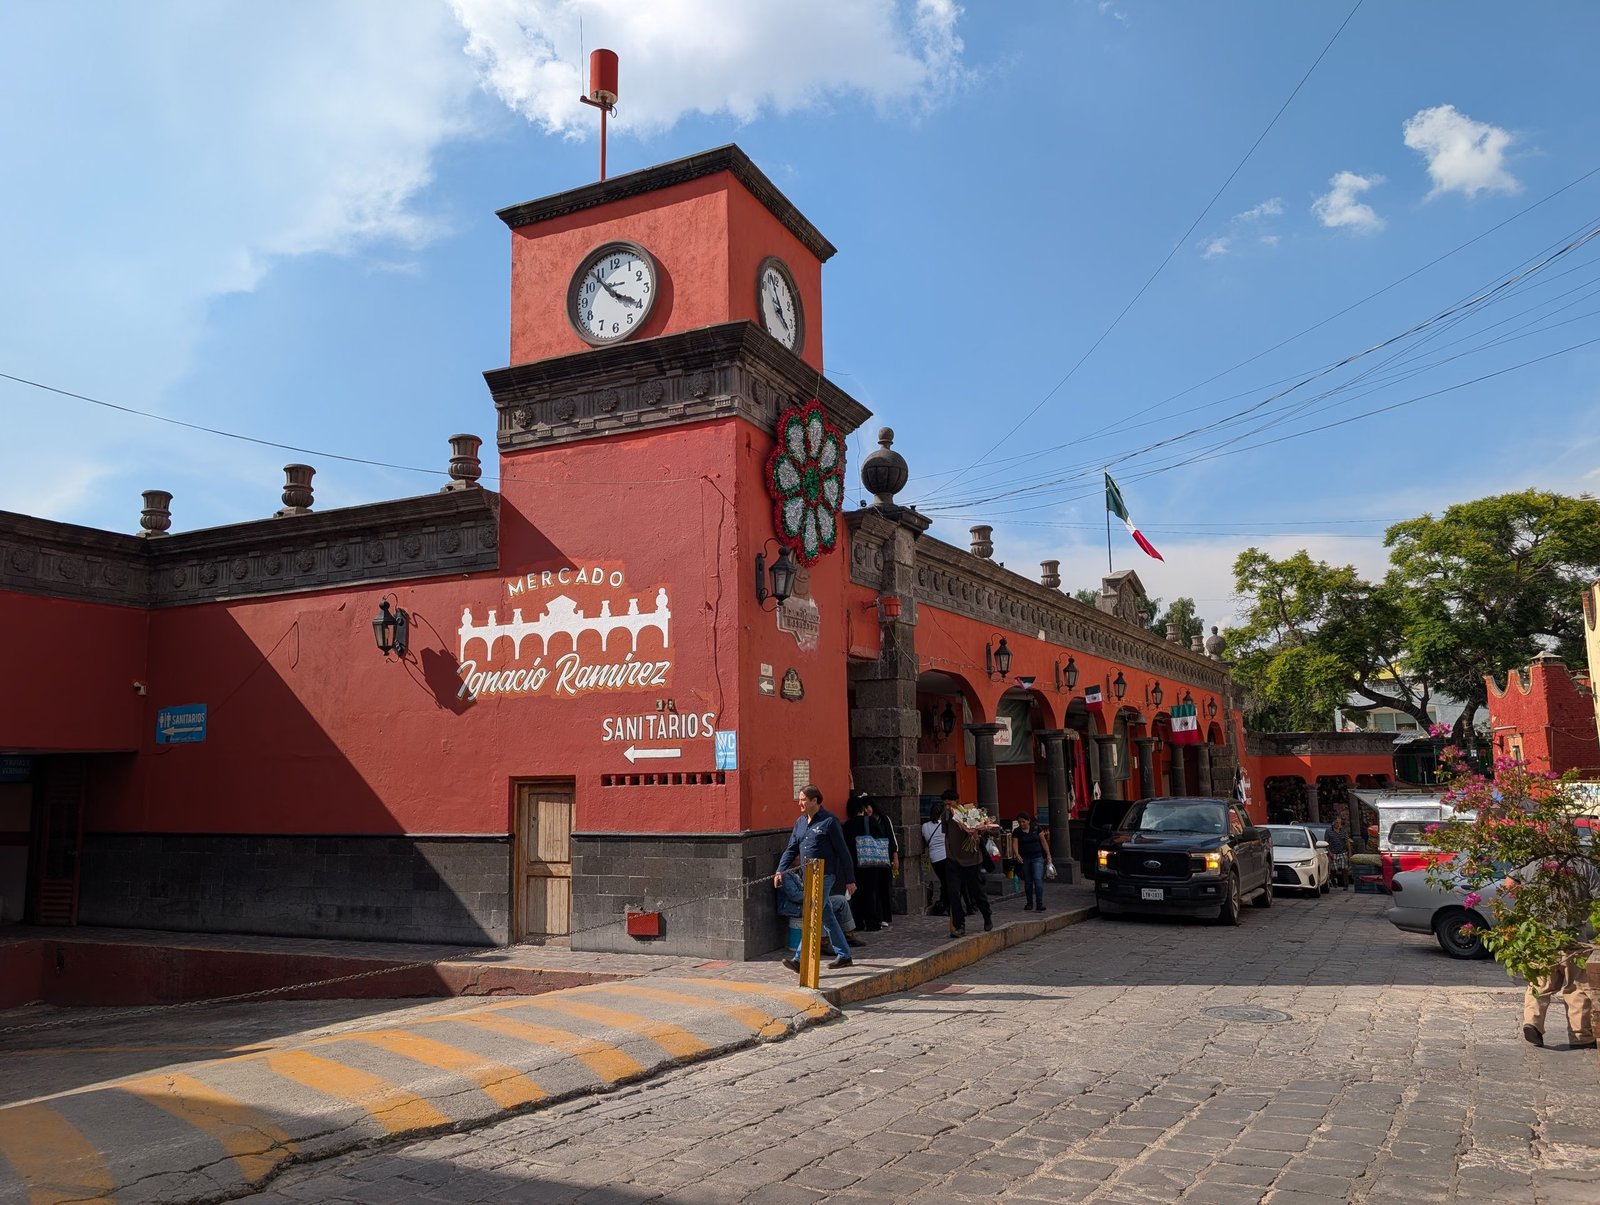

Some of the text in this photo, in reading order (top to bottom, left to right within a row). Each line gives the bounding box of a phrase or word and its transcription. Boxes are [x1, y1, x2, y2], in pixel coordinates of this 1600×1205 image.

[610, 258, 620, 271] 12
[628, 261, 631, 271] 1
[597, 267, 604, 279] 11
[635, 270, 643, 282] 2
[585, 282, 595, 294] 10
[642, 282, 650, 293] 3
[581, 298, 588, 308] 9
[635, 298, 643, 309] 4
[786, 301, 790, 312] 2
[587, 310, 593, 321] 8
[626, 313, 633, 324] 5
[598, 320, 604, 331] 7
[612, 322, 619, 333] 6
[507, 566, 623, 597] MERCADO
[555, 652, 671, 695] Ramírez
[172, 712, 205, 725] SANITARIOS
[602, 712, 716, 741] SANITARIOS
[716, 732, 736, 750] WC
